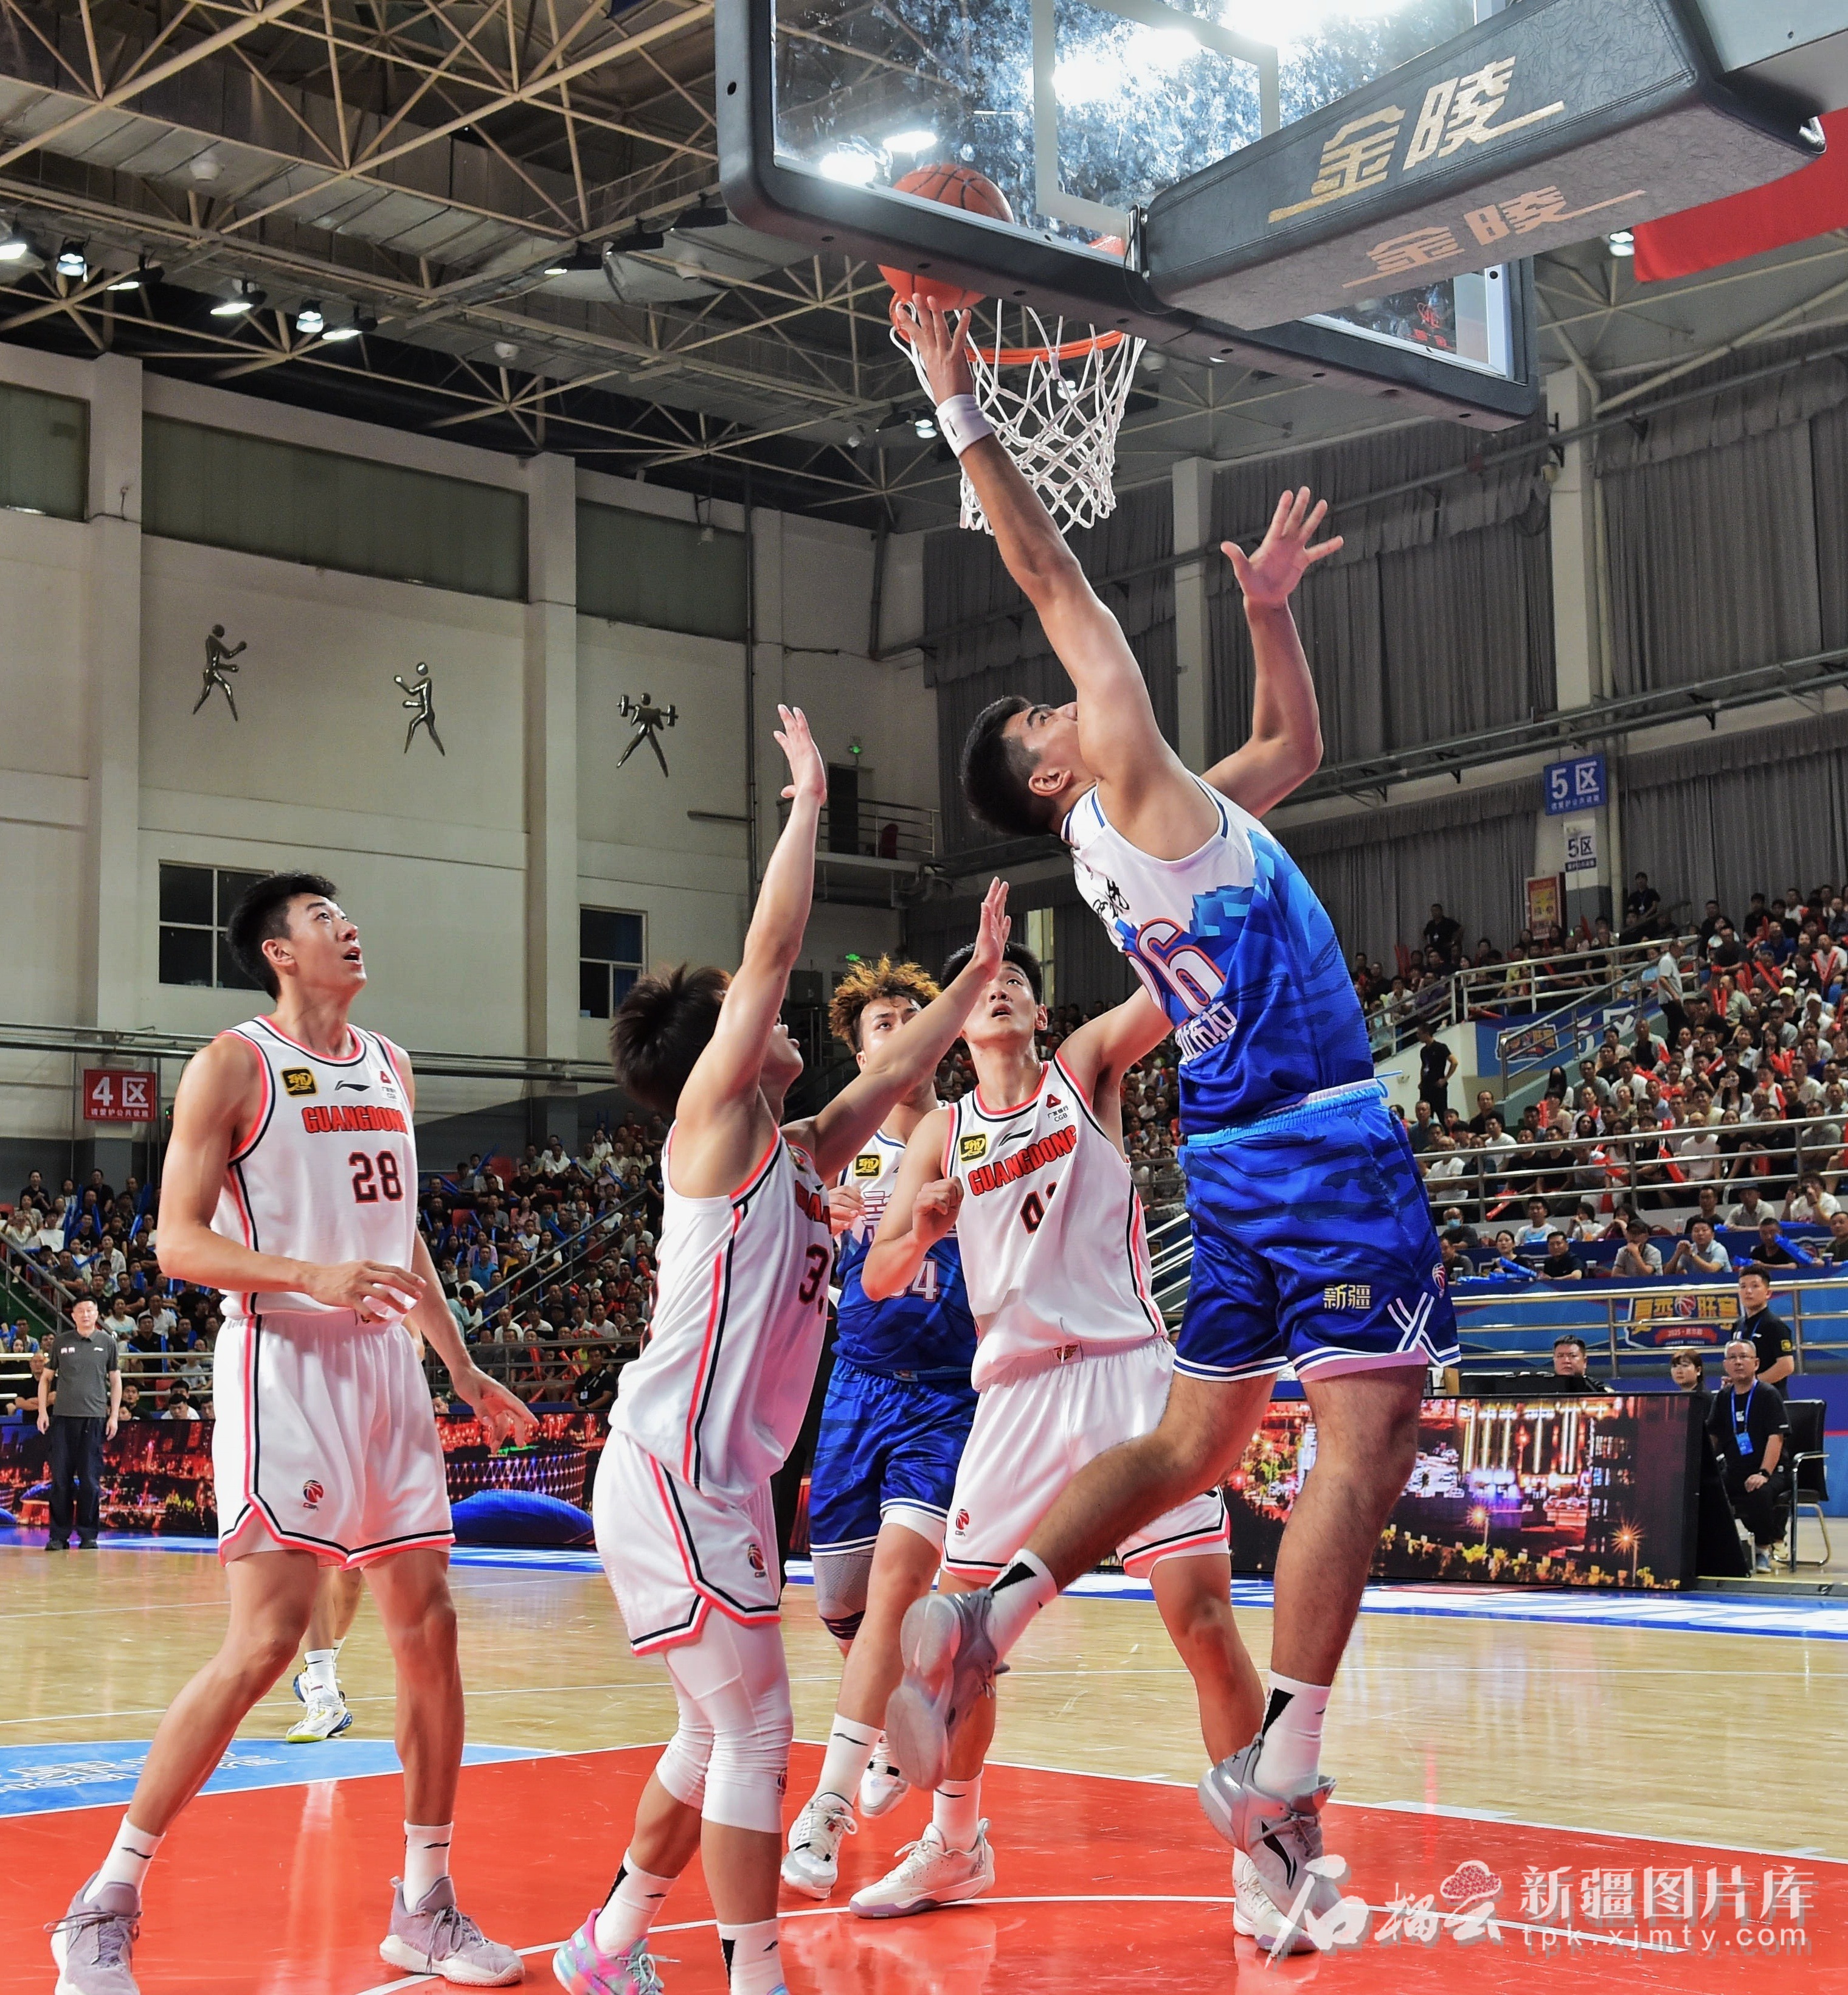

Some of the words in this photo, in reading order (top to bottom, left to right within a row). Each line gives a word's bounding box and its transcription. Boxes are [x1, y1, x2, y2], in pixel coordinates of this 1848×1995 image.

[1268, 55, 1565, 224] 金陵
[1341, 184, 1647, 289] 金陵
[1551, 760, 1600, 800] 5区
[1568, 836, 1593, 858] 5区
[92, 1076, 149, 1108] 4区
[1054, 1112, 1068, 1122] CGB
[348, 1150, 404, 1204] 28
[1323, 1283, 1371, 1310] 新疆
